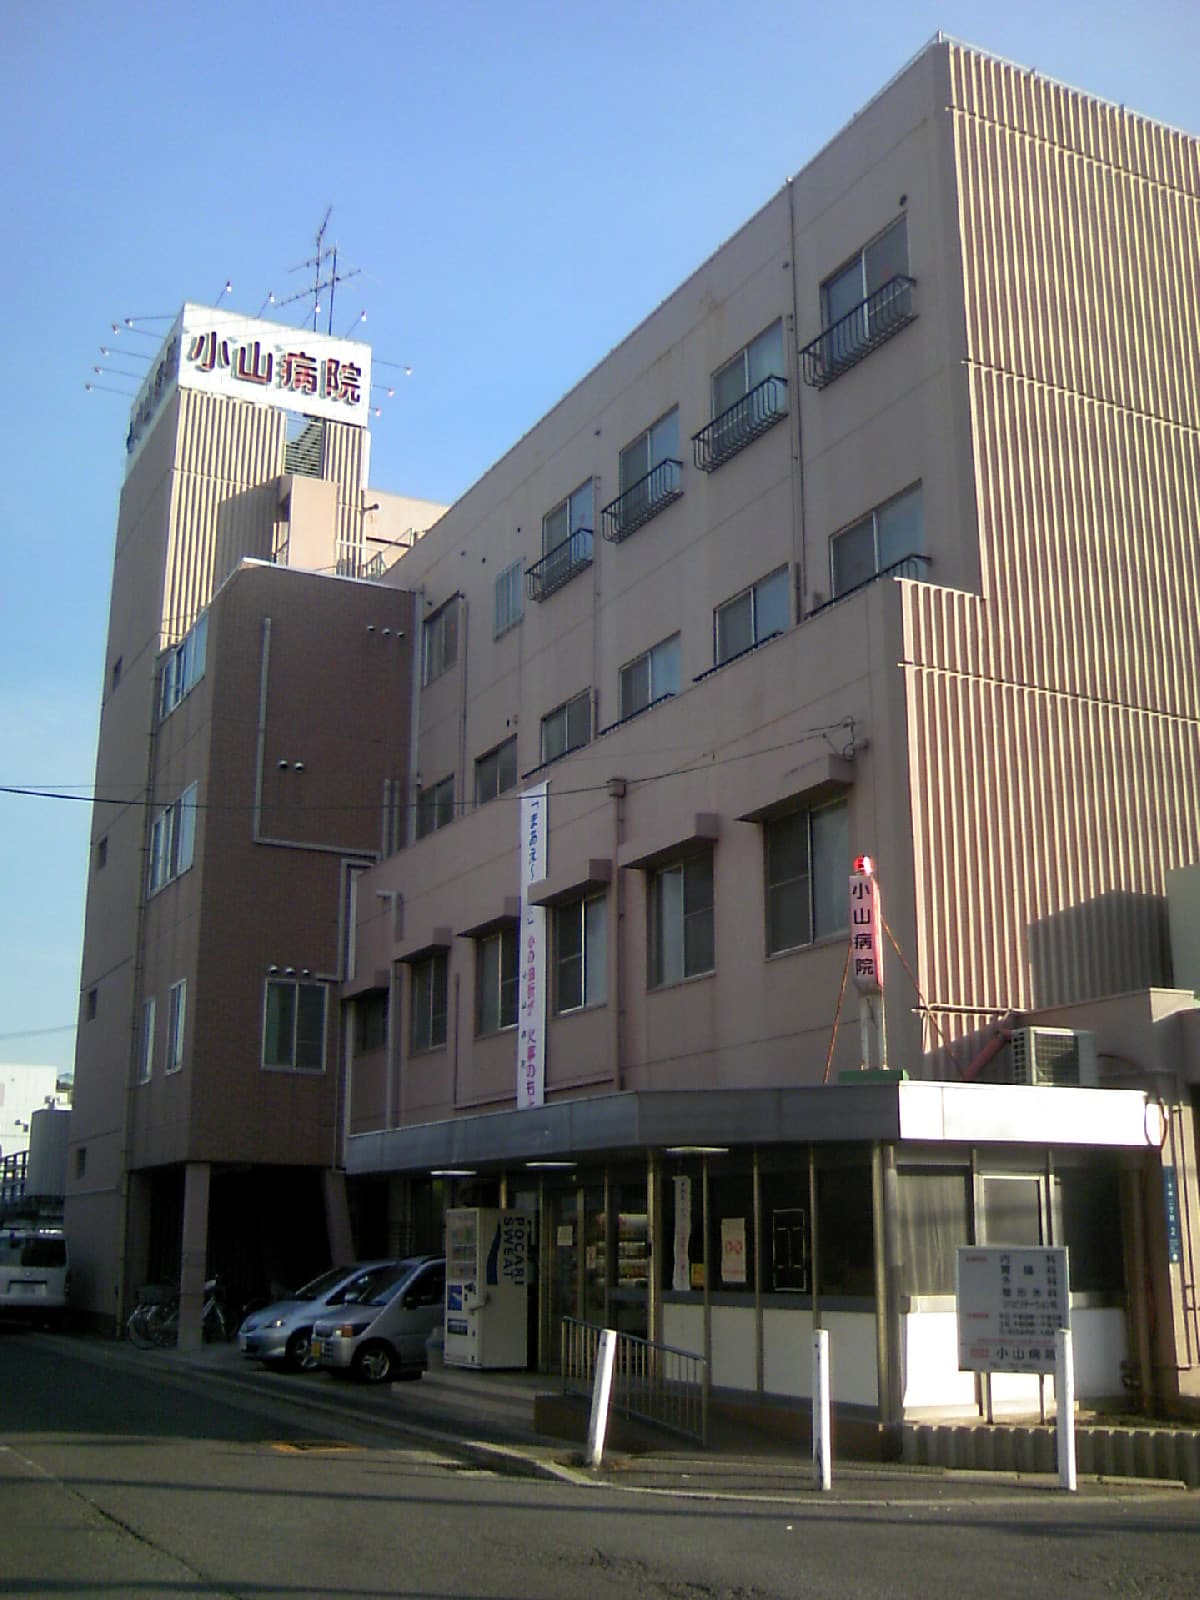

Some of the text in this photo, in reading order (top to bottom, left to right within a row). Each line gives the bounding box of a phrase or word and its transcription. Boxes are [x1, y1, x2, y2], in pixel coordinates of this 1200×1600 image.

[190, 331, 361, 403] 小山病院
[852, 882, 874, 976] 小山病院
[503, 1216, 513, 1277] SWEAT
[514, 1216, 525, 1285] POCARI
